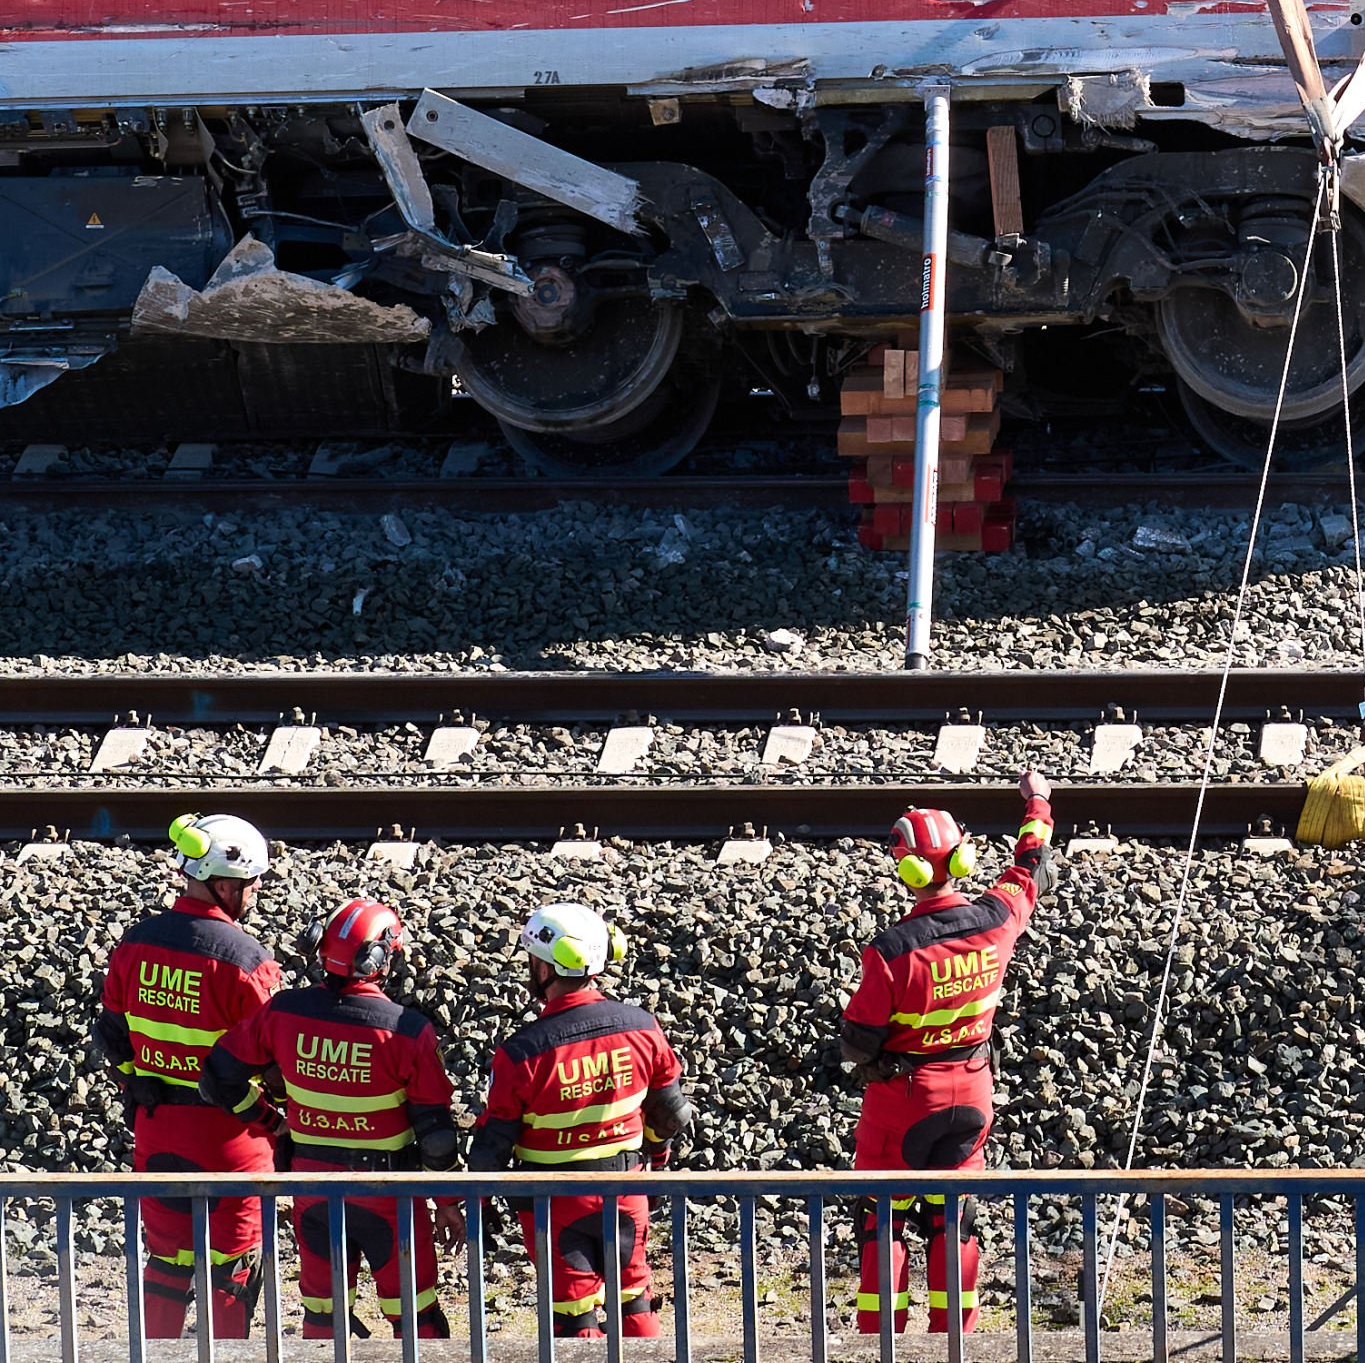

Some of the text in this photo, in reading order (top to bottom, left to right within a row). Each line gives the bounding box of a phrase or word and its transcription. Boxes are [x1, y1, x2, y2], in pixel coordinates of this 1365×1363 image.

[533, 70, 561, 85] 27A
[921, 257, 932, 309] holmatro
[139, 960, 203, 997] UME
[930, 944, 1000, 983] UME
[138, 987, 201, 1015] RESCATE
[933, 969, 999, 1001] RESCATE
[296, 1032, 373, 1067] UME
[557, 1046, 633, 1085] UME
[296, 1059, 372, 1084] RESCATE
[560, 1071, 633, 1102] RESCATE
[299, 1109, 376, 1132] U.S.A.R.
